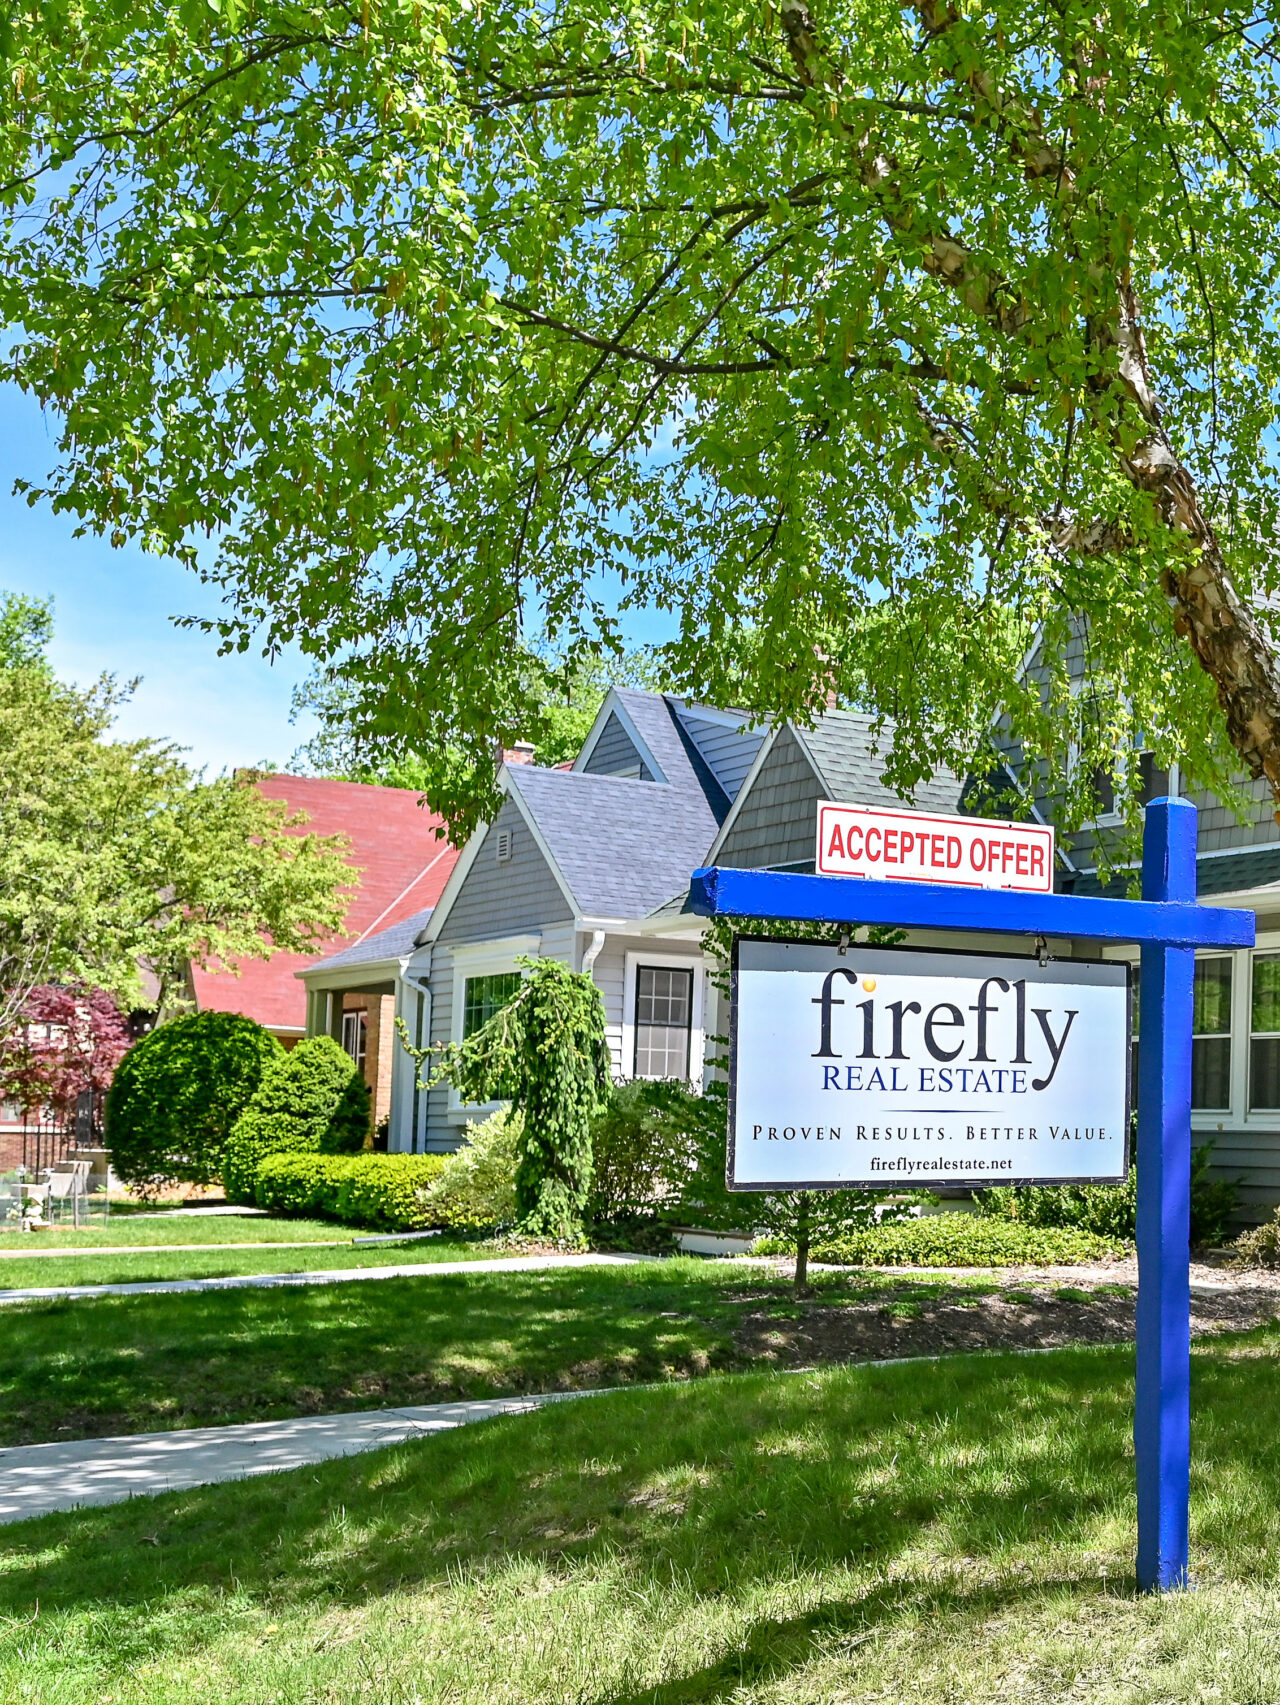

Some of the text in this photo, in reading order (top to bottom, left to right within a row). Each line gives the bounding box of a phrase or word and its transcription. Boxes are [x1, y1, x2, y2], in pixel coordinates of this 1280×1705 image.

[828, 823, 1045, 877] ACCEPTED OFFER
[811, 967, 1080, 1091] firefly
[821, 1065, 1028, 1094] REAL ESTATE
[752, 1124, 842, 1141] PROVEN
[966, 1125, 1039, 1141] BETTER
[870, 1157, 1013, 1175] fireflyrealestate.net
